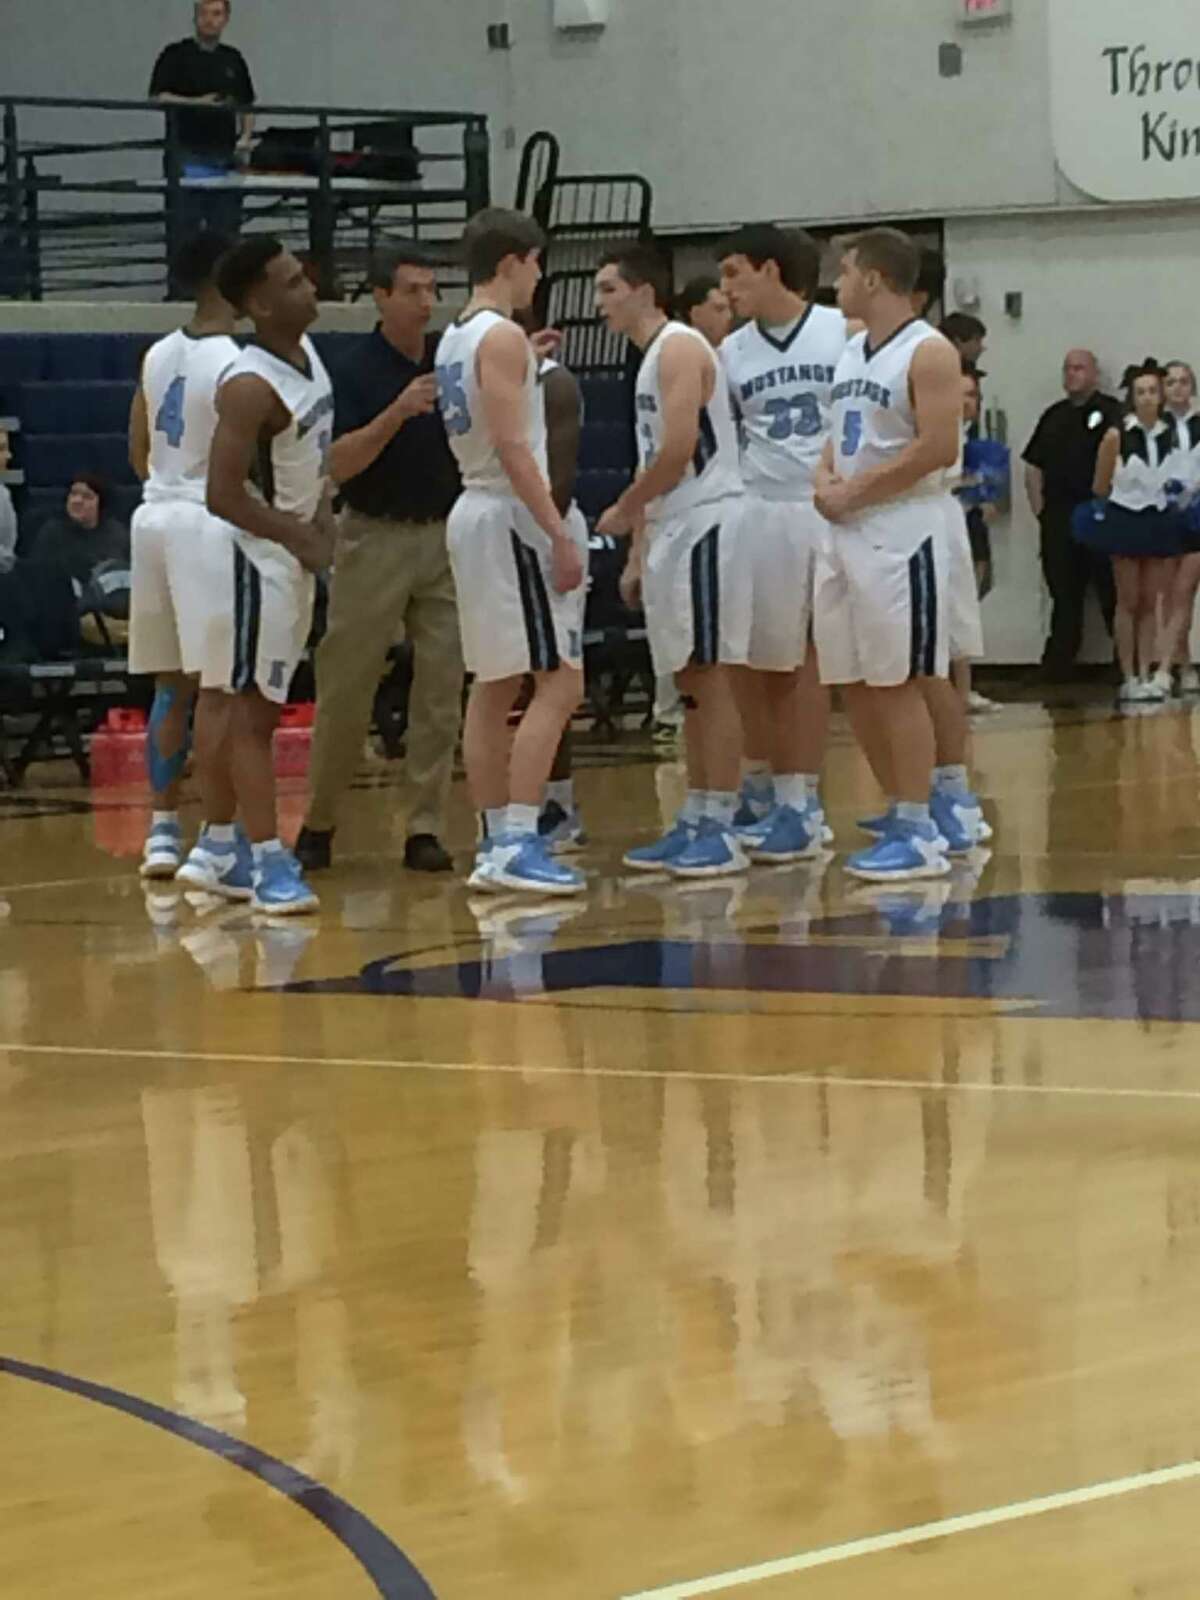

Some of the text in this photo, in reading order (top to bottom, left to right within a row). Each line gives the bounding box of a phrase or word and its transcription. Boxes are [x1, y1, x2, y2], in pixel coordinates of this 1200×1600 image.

[741, 364, 835, 400] MUSTANGS
[155, 376, 186, 448] 4
[841, 410, 862, 456] 5
